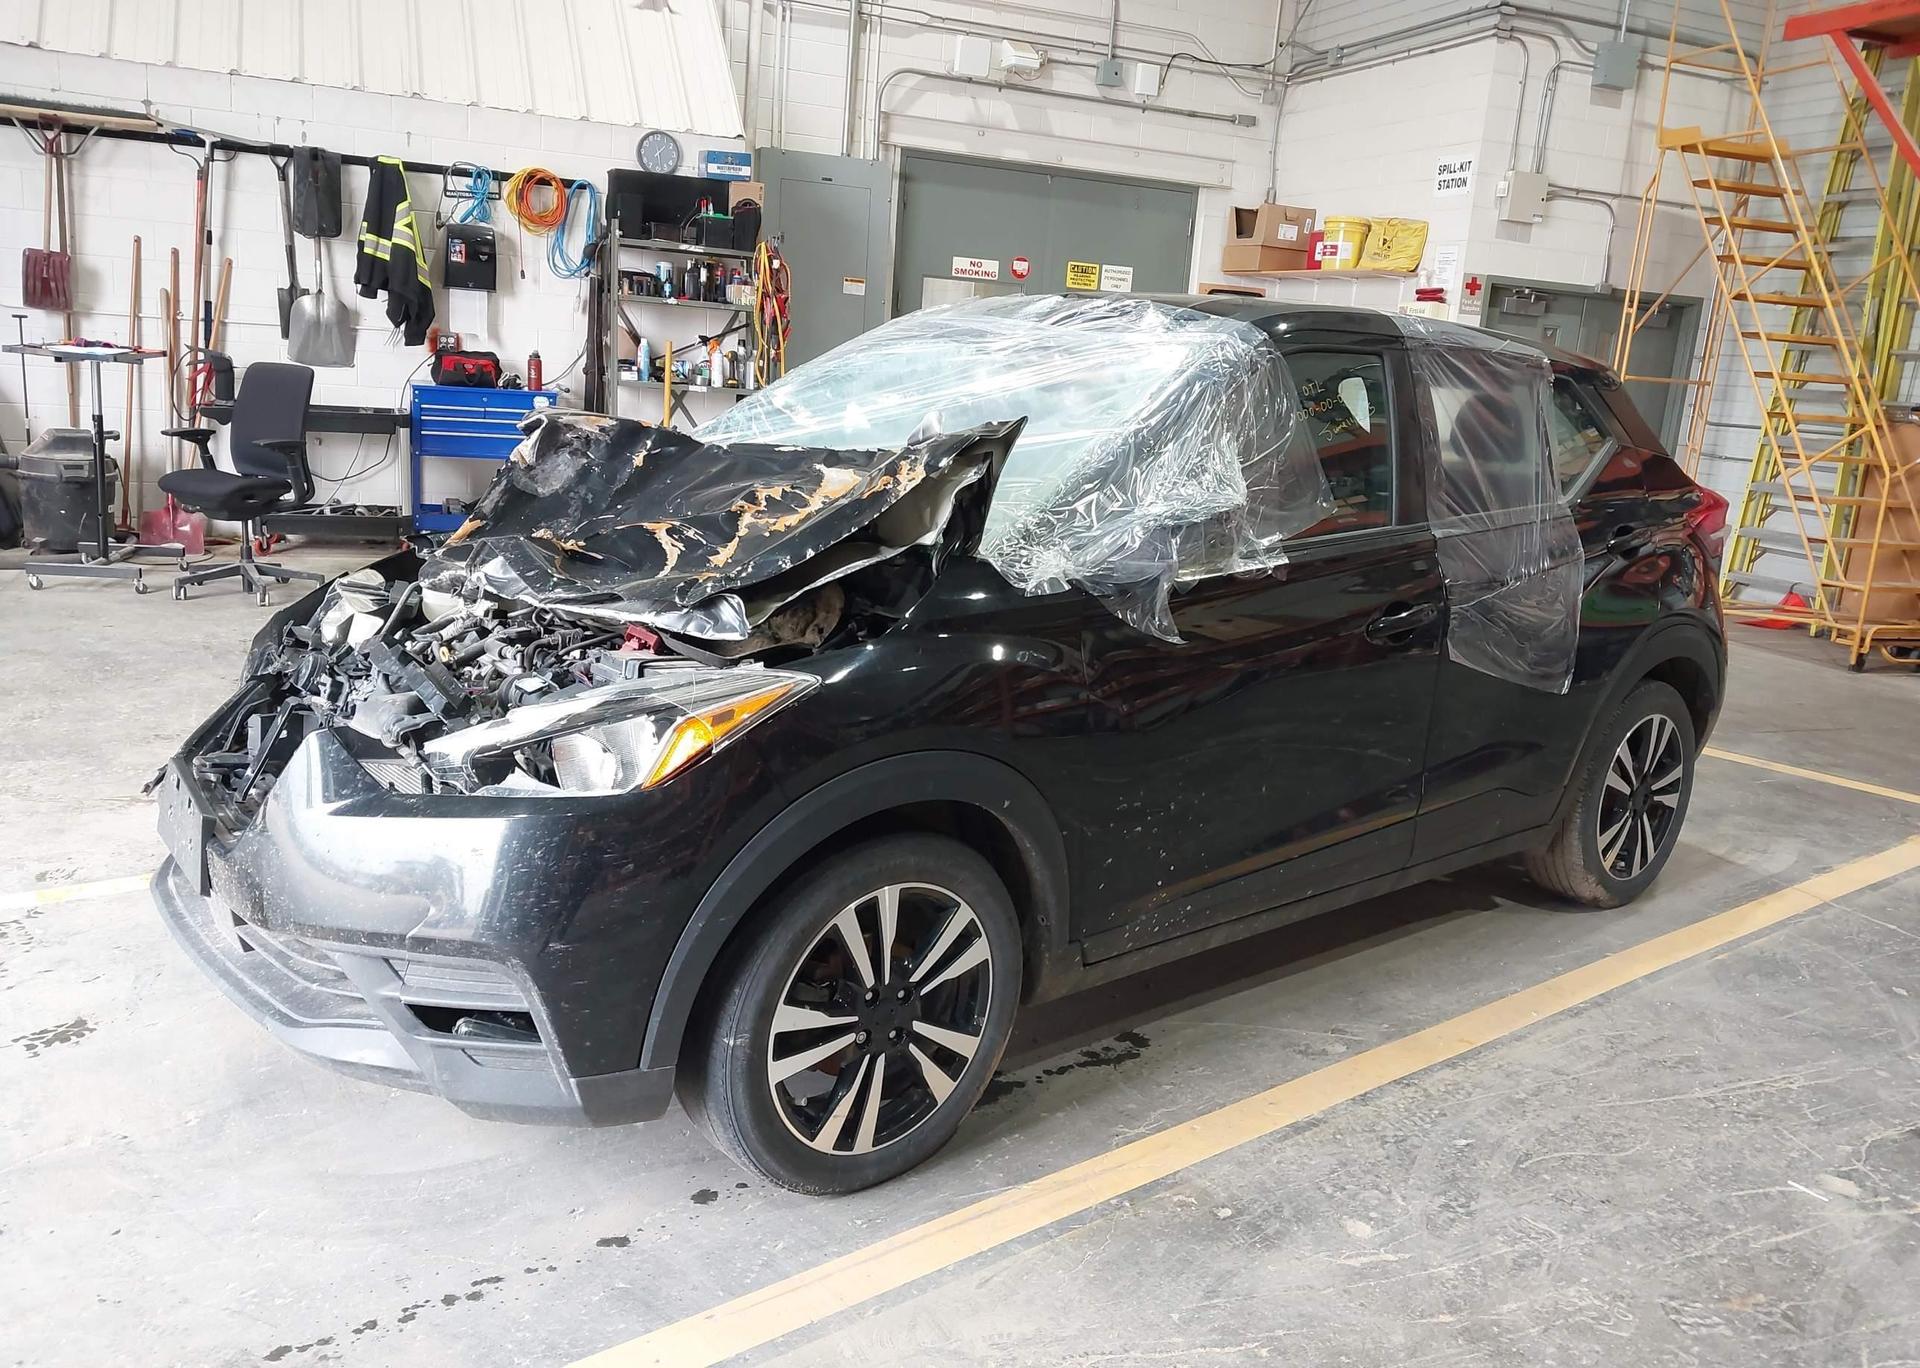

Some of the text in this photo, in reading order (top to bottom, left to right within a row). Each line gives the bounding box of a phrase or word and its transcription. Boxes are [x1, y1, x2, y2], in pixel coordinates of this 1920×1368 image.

[1438, 160, 1472, 175] SPILL-KIT
[1437, 176, 1467, 190] STATION
[969, 260, 983, 269] NO
[1070, 264, 1097, 274] CAUTION
[953, 267, 997, 279] SMOKING
